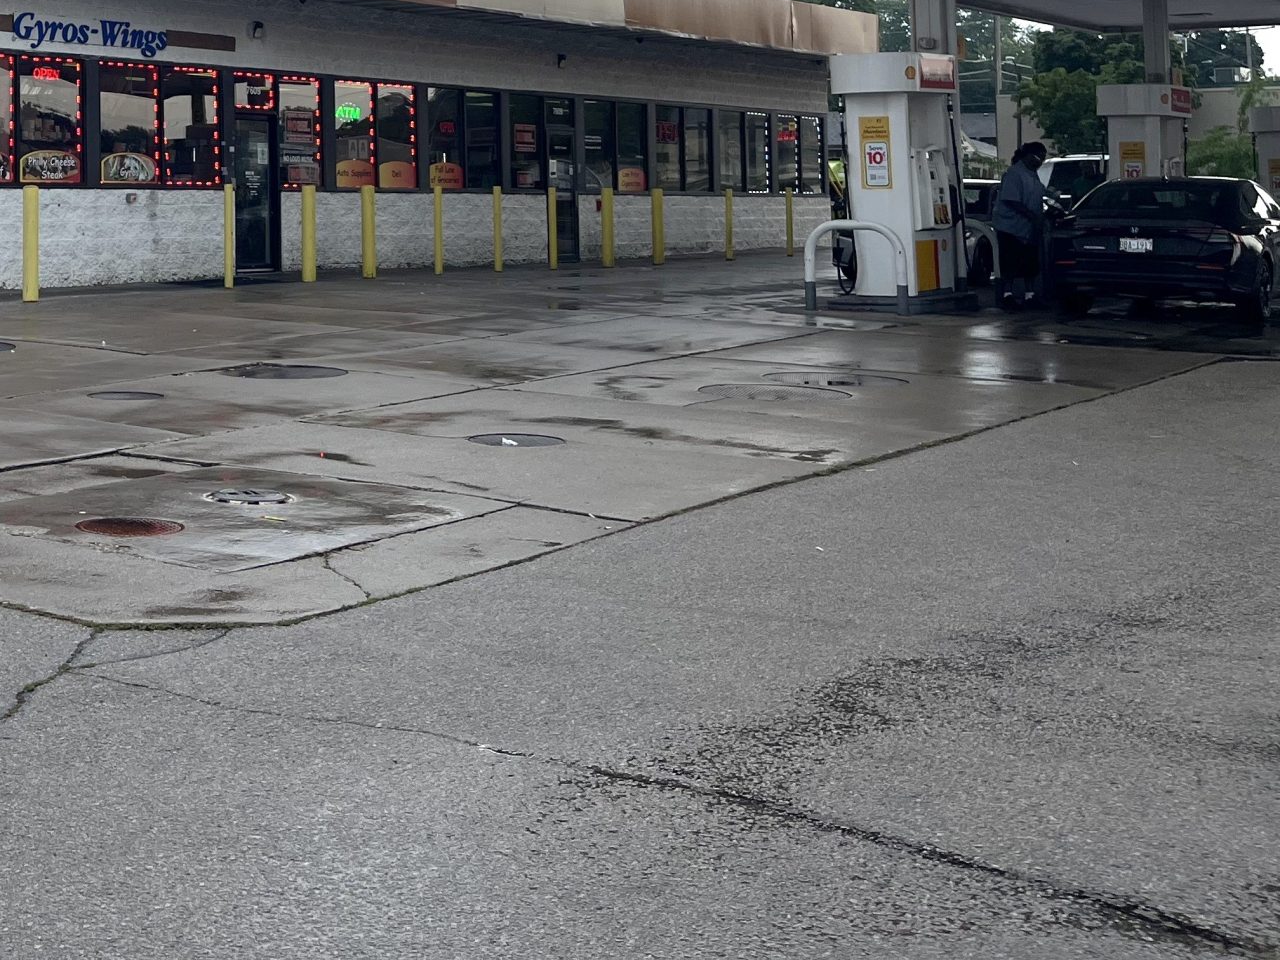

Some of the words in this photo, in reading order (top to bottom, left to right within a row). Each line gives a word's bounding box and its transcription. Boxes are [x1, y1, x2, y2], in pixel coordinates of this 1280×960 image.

[13, 12, 169, 58] Gyros-Wings
[32, 68, 62, 81] OPEN
[335, 106, 361, 119] ATM
[50, 157, 76, 167] Cheese
[41, 170, 64, 180] Steak
